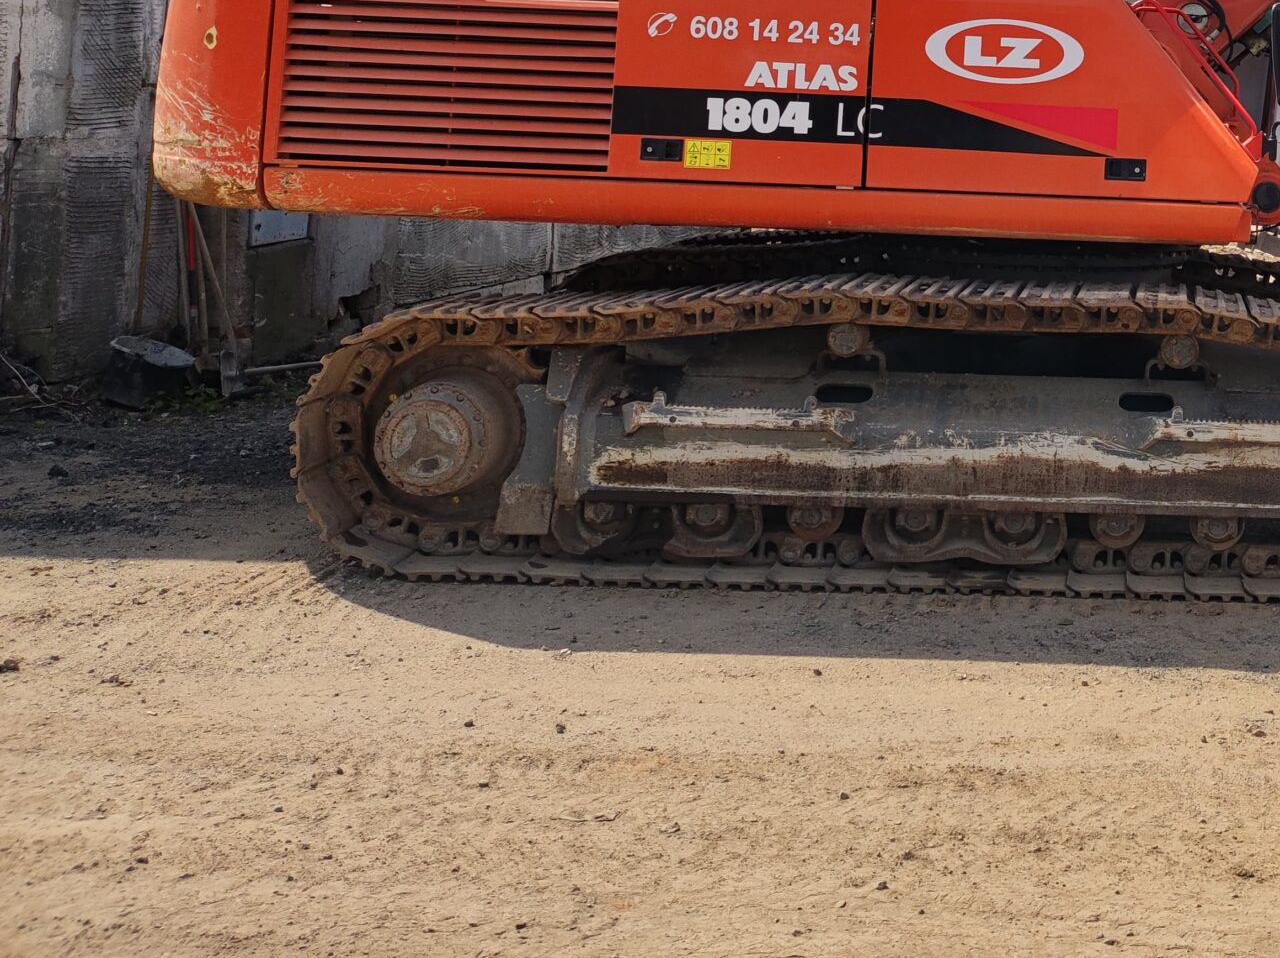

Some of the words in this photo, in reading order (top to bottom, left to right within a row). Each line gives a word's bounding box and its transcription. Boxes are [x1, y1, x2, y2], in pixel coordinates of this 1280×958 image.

[690, 15, 739, 40] 608
[748, 18, 779, 42] 14
[787, 20, 820, 44] 24
[828, 22, 861, 46] 34
[963, 35, 1044, 70] LZ
[744, 61, 858, 92] ATLAS
[707, 97, 813, 135] 1804
[836, 102, 884, 139] LC
